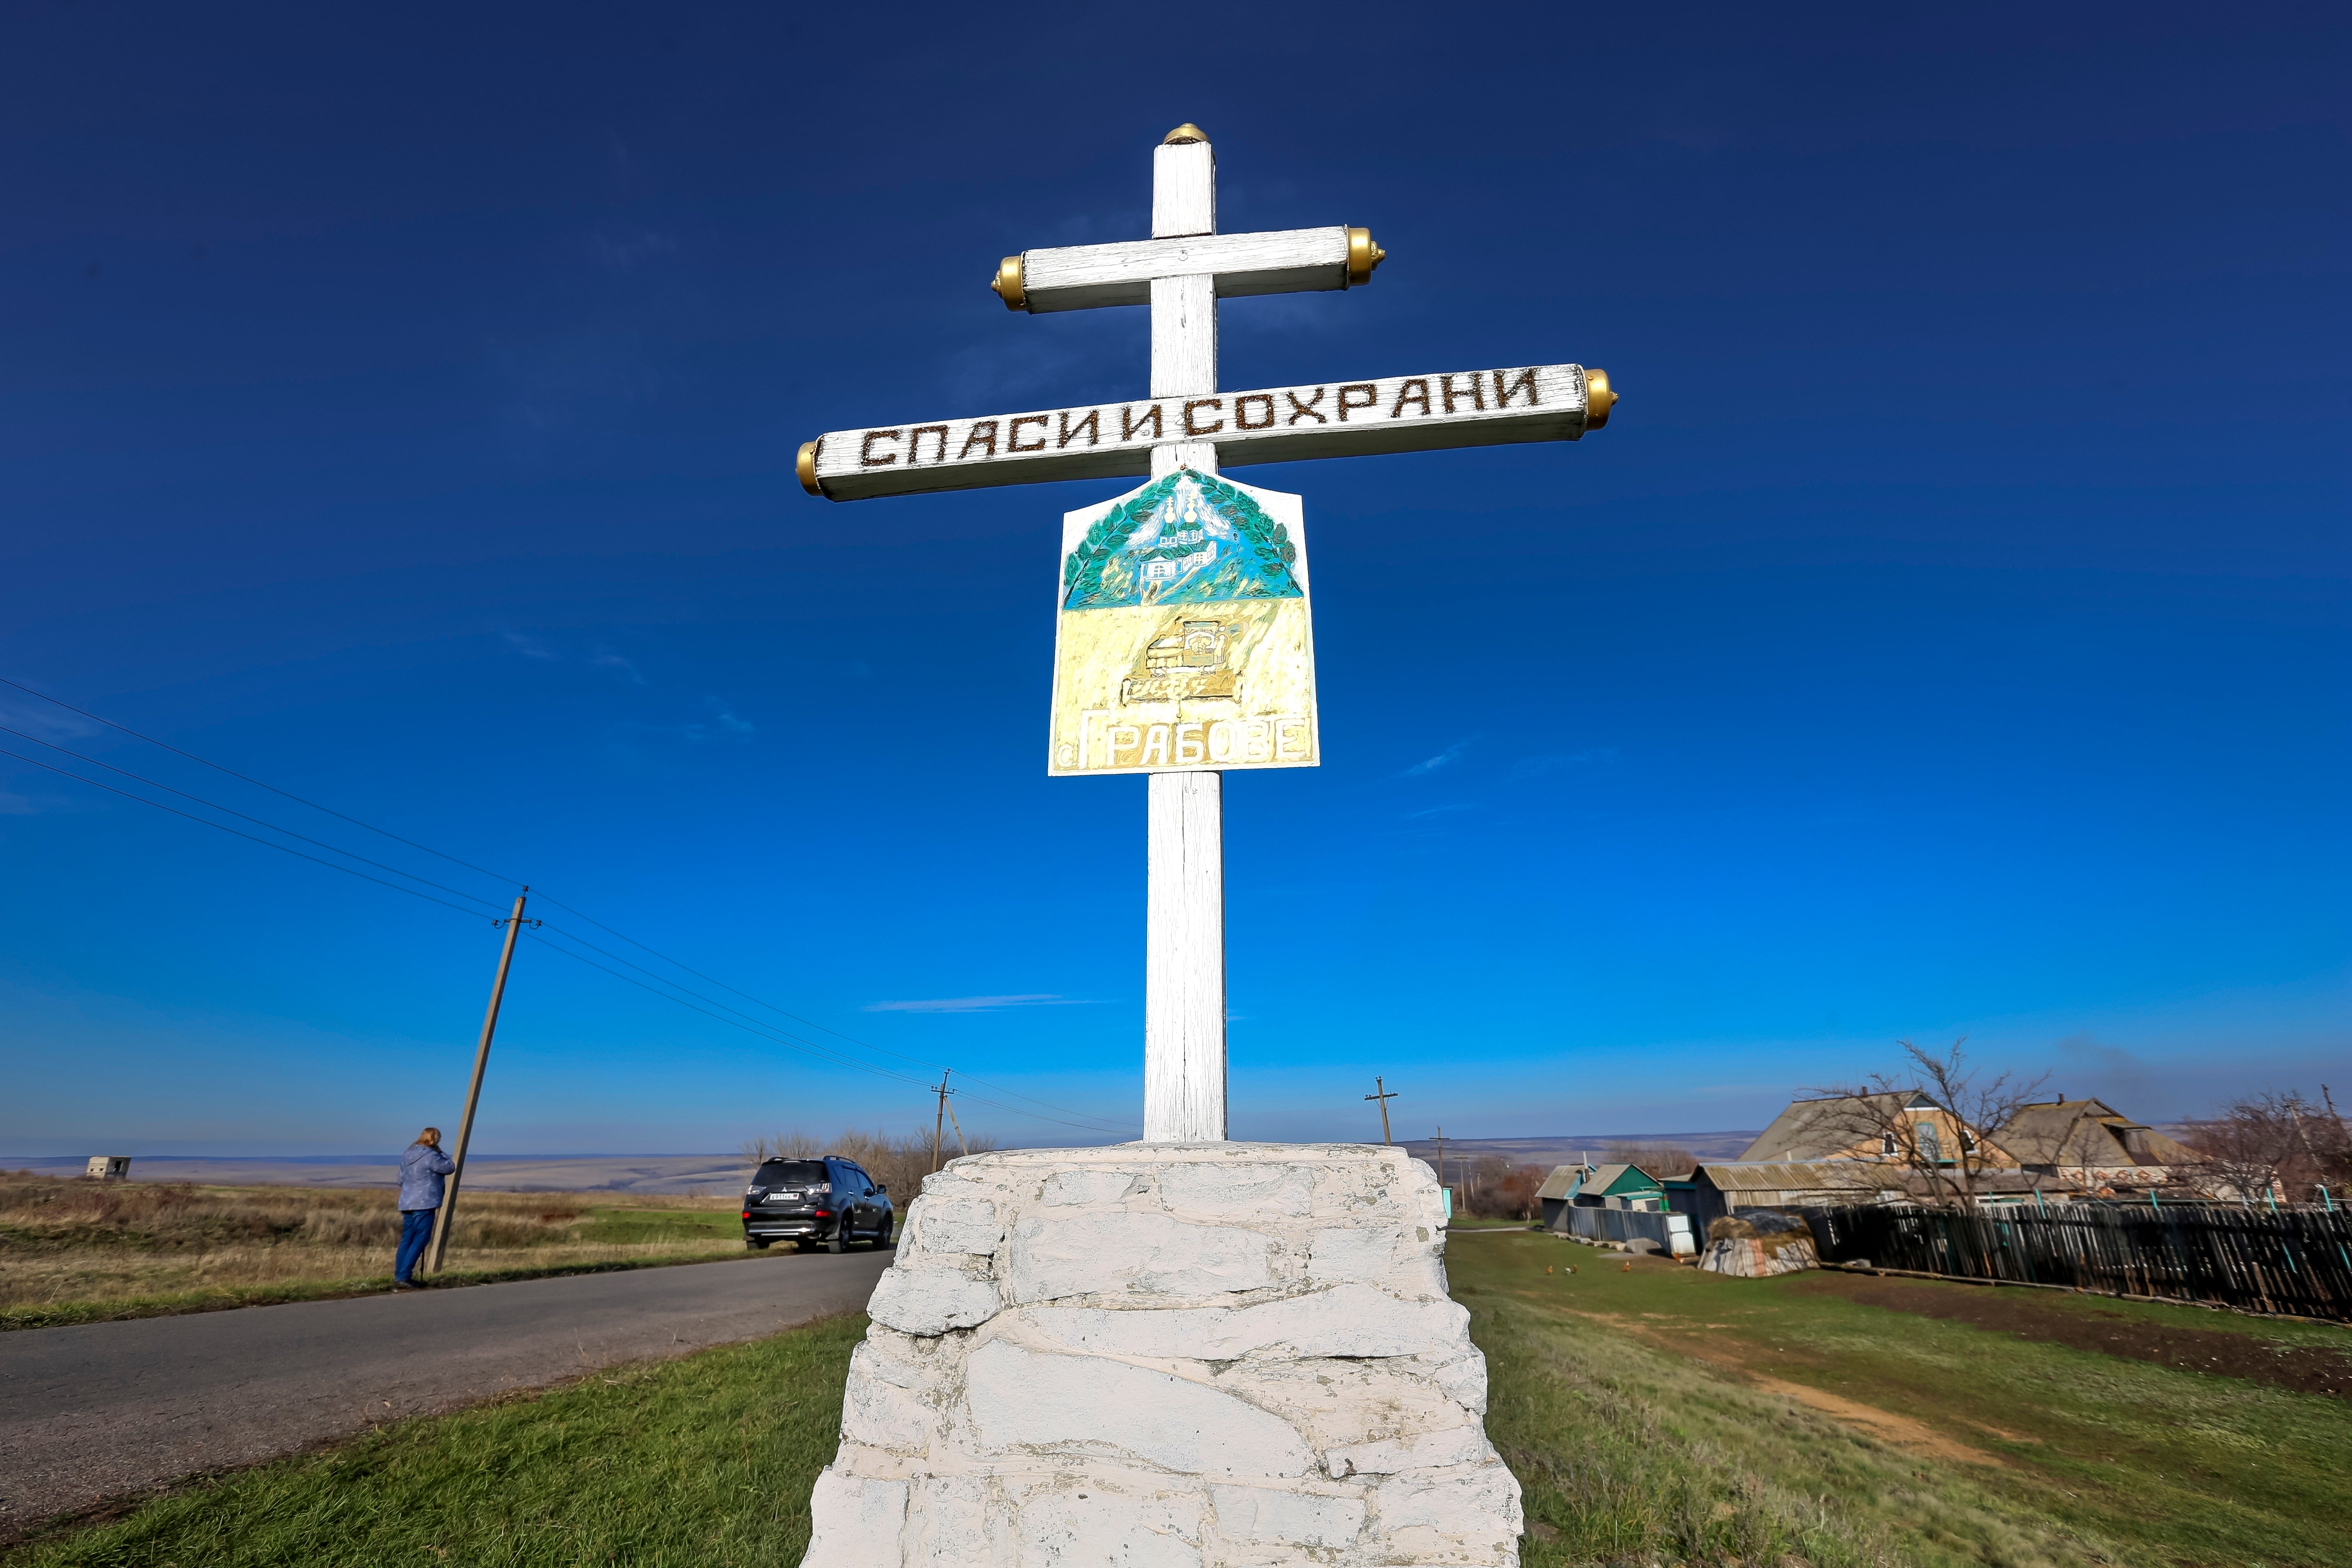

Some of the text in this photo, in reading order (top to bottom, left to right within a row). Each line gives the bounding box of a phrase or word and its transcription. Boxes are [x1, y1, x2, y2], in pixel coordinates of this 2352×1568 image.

[861, 367, 1539, 467] СПАСИ И СОХРАНИ
[1078, 709, 1307, 770] ГРАБОВЕ
